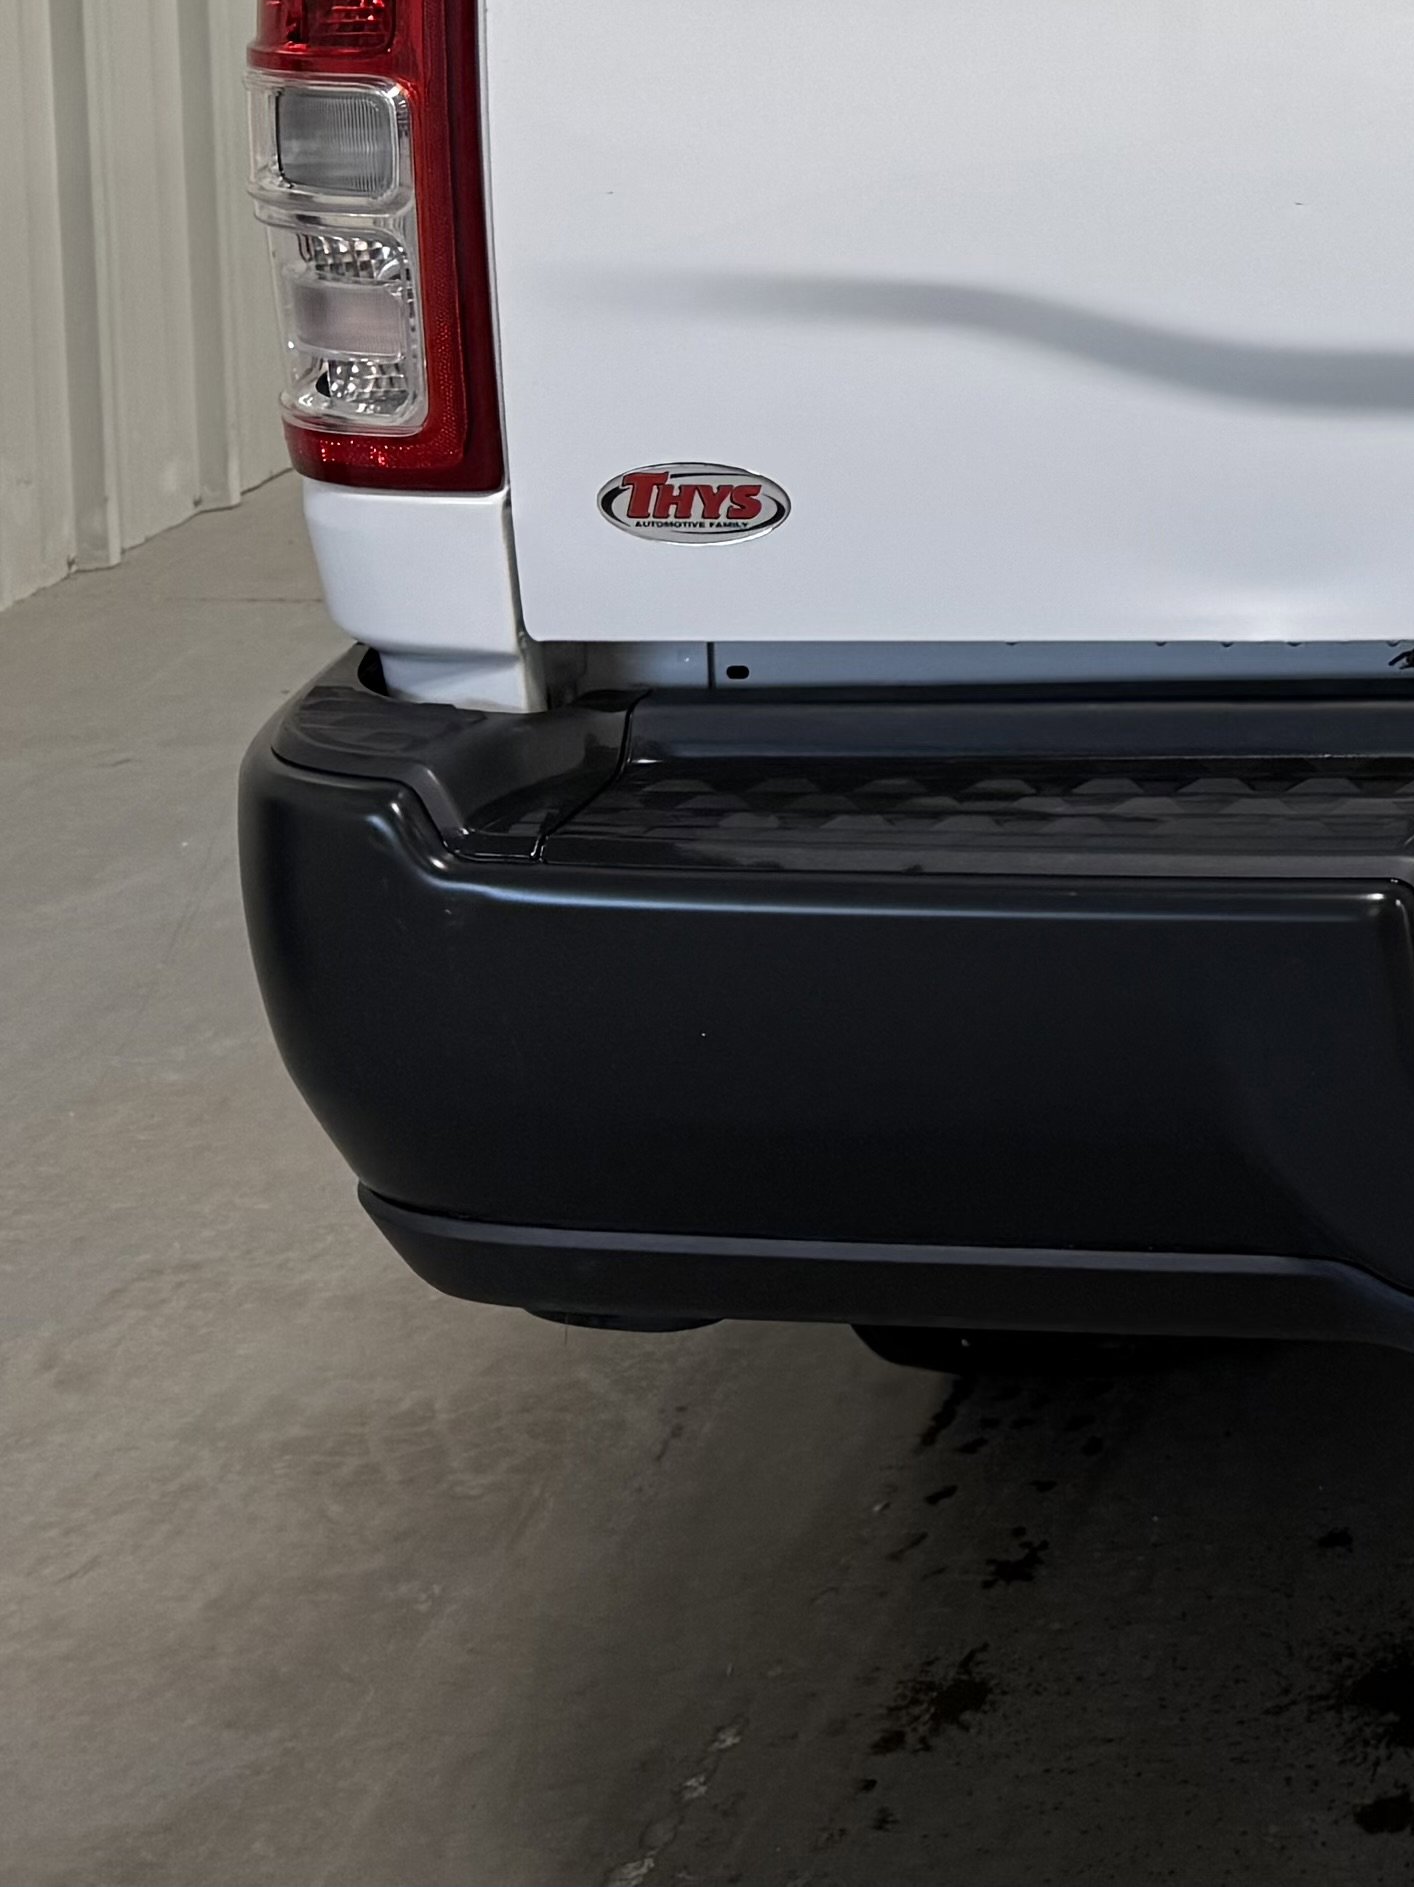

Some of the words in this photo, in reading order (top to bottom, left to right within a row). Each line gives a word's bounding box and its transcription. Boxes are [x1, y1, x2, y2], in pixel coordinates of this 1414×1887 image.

[621, 470, 763, 520] THYS
[635, 520, 706, 529] AUTOMOTIVE
[709, 520, 749, 529] FAMILY
